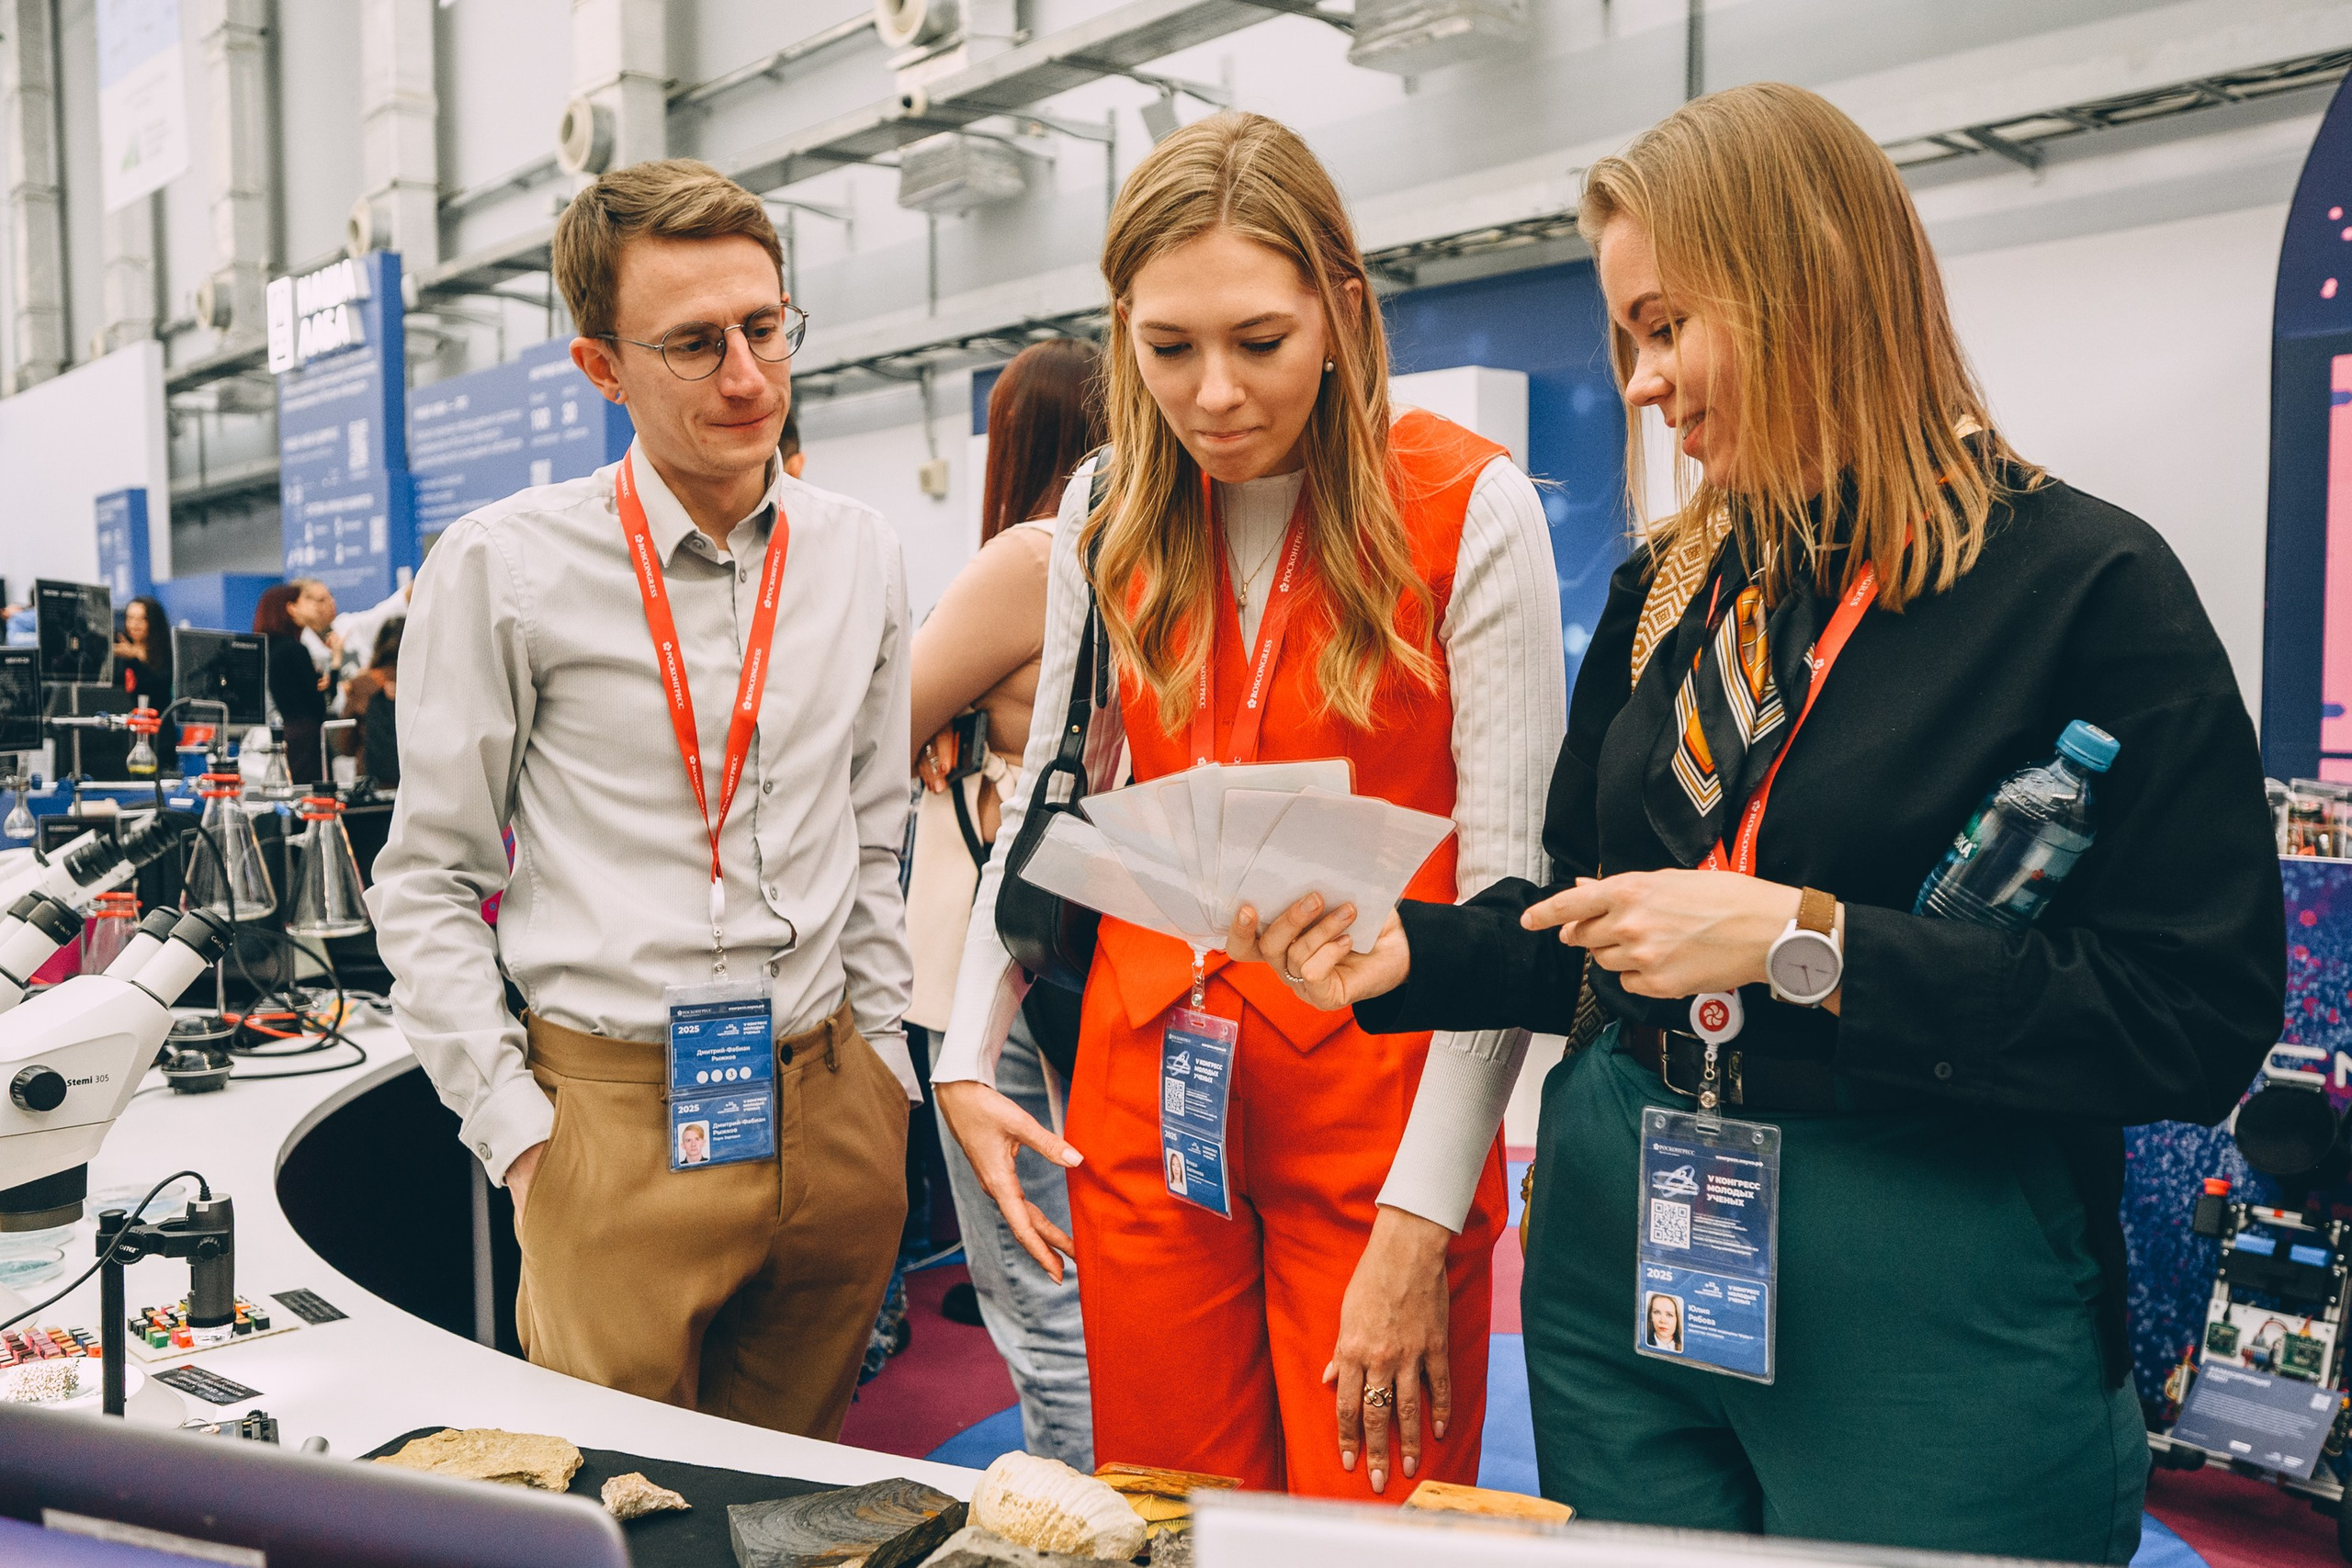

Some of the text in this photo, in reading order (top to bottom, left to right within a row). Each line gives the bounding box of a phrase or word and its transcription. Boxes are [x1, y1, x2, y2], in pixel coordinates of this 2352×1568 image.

[1283, 523, 1306, 583] РОСКОНГРЕСС
[638, 541, 659, 598] ROSCONGRESS
[768, 548, 781, 600] РОСКОНГРЕСС
[746, 648, 762, 702] ROSCONGRESS
[1250, 639, 1273, 699] ROSCONGRESS
[666, 651, 684, 710] РОСКОНГРЕСС
[678, 1025, 700, 1034] 2025
[1200, 1059, 1223, 1071] КОНГРЕСС
[67, 1074, 109, 1087] Stemi 305
[678, 1104, 699, 1114] 2025
[1165, 1130, 1177, 1140] 2025
[1659, 1145, 1695, 1156] РОСКОНГРЕСС
[1707, 1174, 1714, 1183] V
[1715, 1176, 1761, 1190] КОНГРЕСС
[1706, 1184, 1754, 1199] МОЛОДЫХ
[1706, 1193, 1744, 1207] УЧЕНЫХ
[1647, 1267, 1673, 1282] 2025
[1688, 1305, 1710, 1315] Юлия
[1688, 1314, 1716, 1326] Рябова
